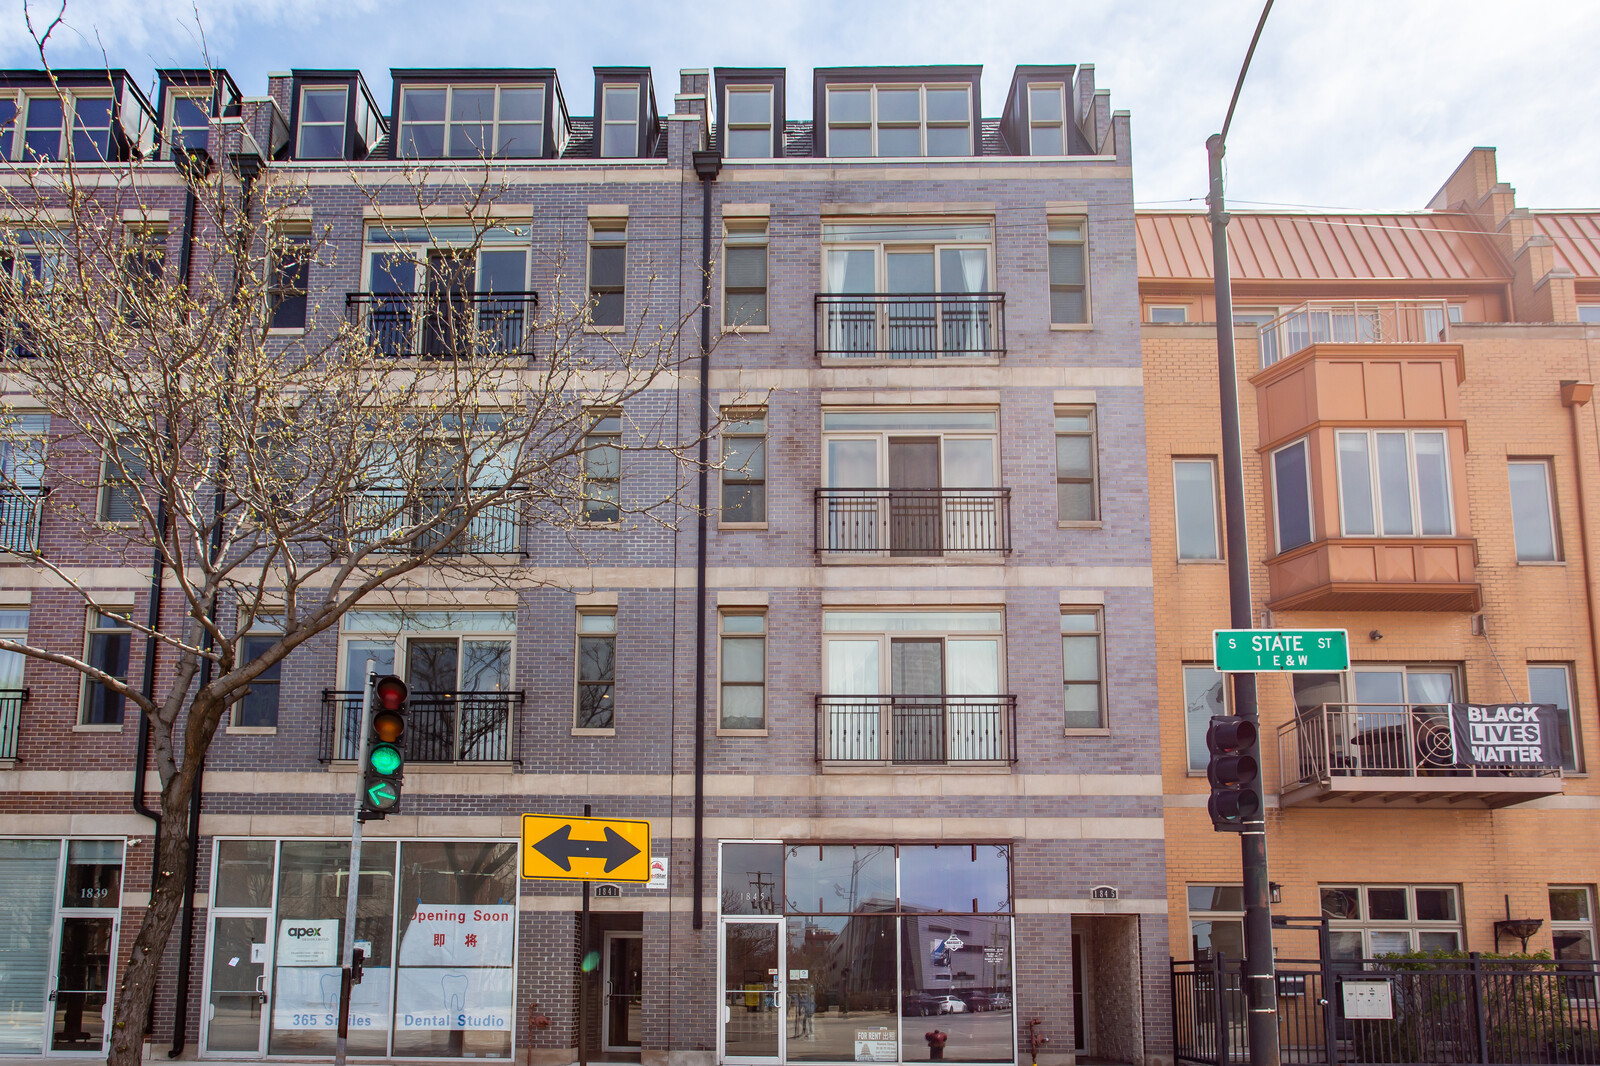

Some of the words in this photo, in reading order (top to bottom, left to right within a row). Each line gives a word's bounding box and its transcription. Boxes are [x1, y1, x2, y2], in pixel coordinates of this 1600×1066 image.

[1228, 638, 1237, 649] S
[1251, 635, 1304, 651] STATE
[1317, 637, 1332, 649] ST
[1468, 706, 1540, 722] BLACK
[1471, 725, 1539, 742] LIVES
[1471, 746, 1543, 762] MATTER
[81, 888, 108, 899] 1839
[598, 887, 617, 896] 1841
[740, 892, 765, 901] 1845
[1094, 890, 1115, 898] 1845
[473, 909, 509, 922] Soon
[287, 927, 322, 940] apex
[292, 1014, 317, 1026] 365
[324, 1014, 371, 1026] Siles
[404, 1014, 450, 1026] Dental
[457, 1014, 504, 1027] Studio
[857, 1031, 867, 1040] FOR
[868, 1031, 881, 1040] RENT
